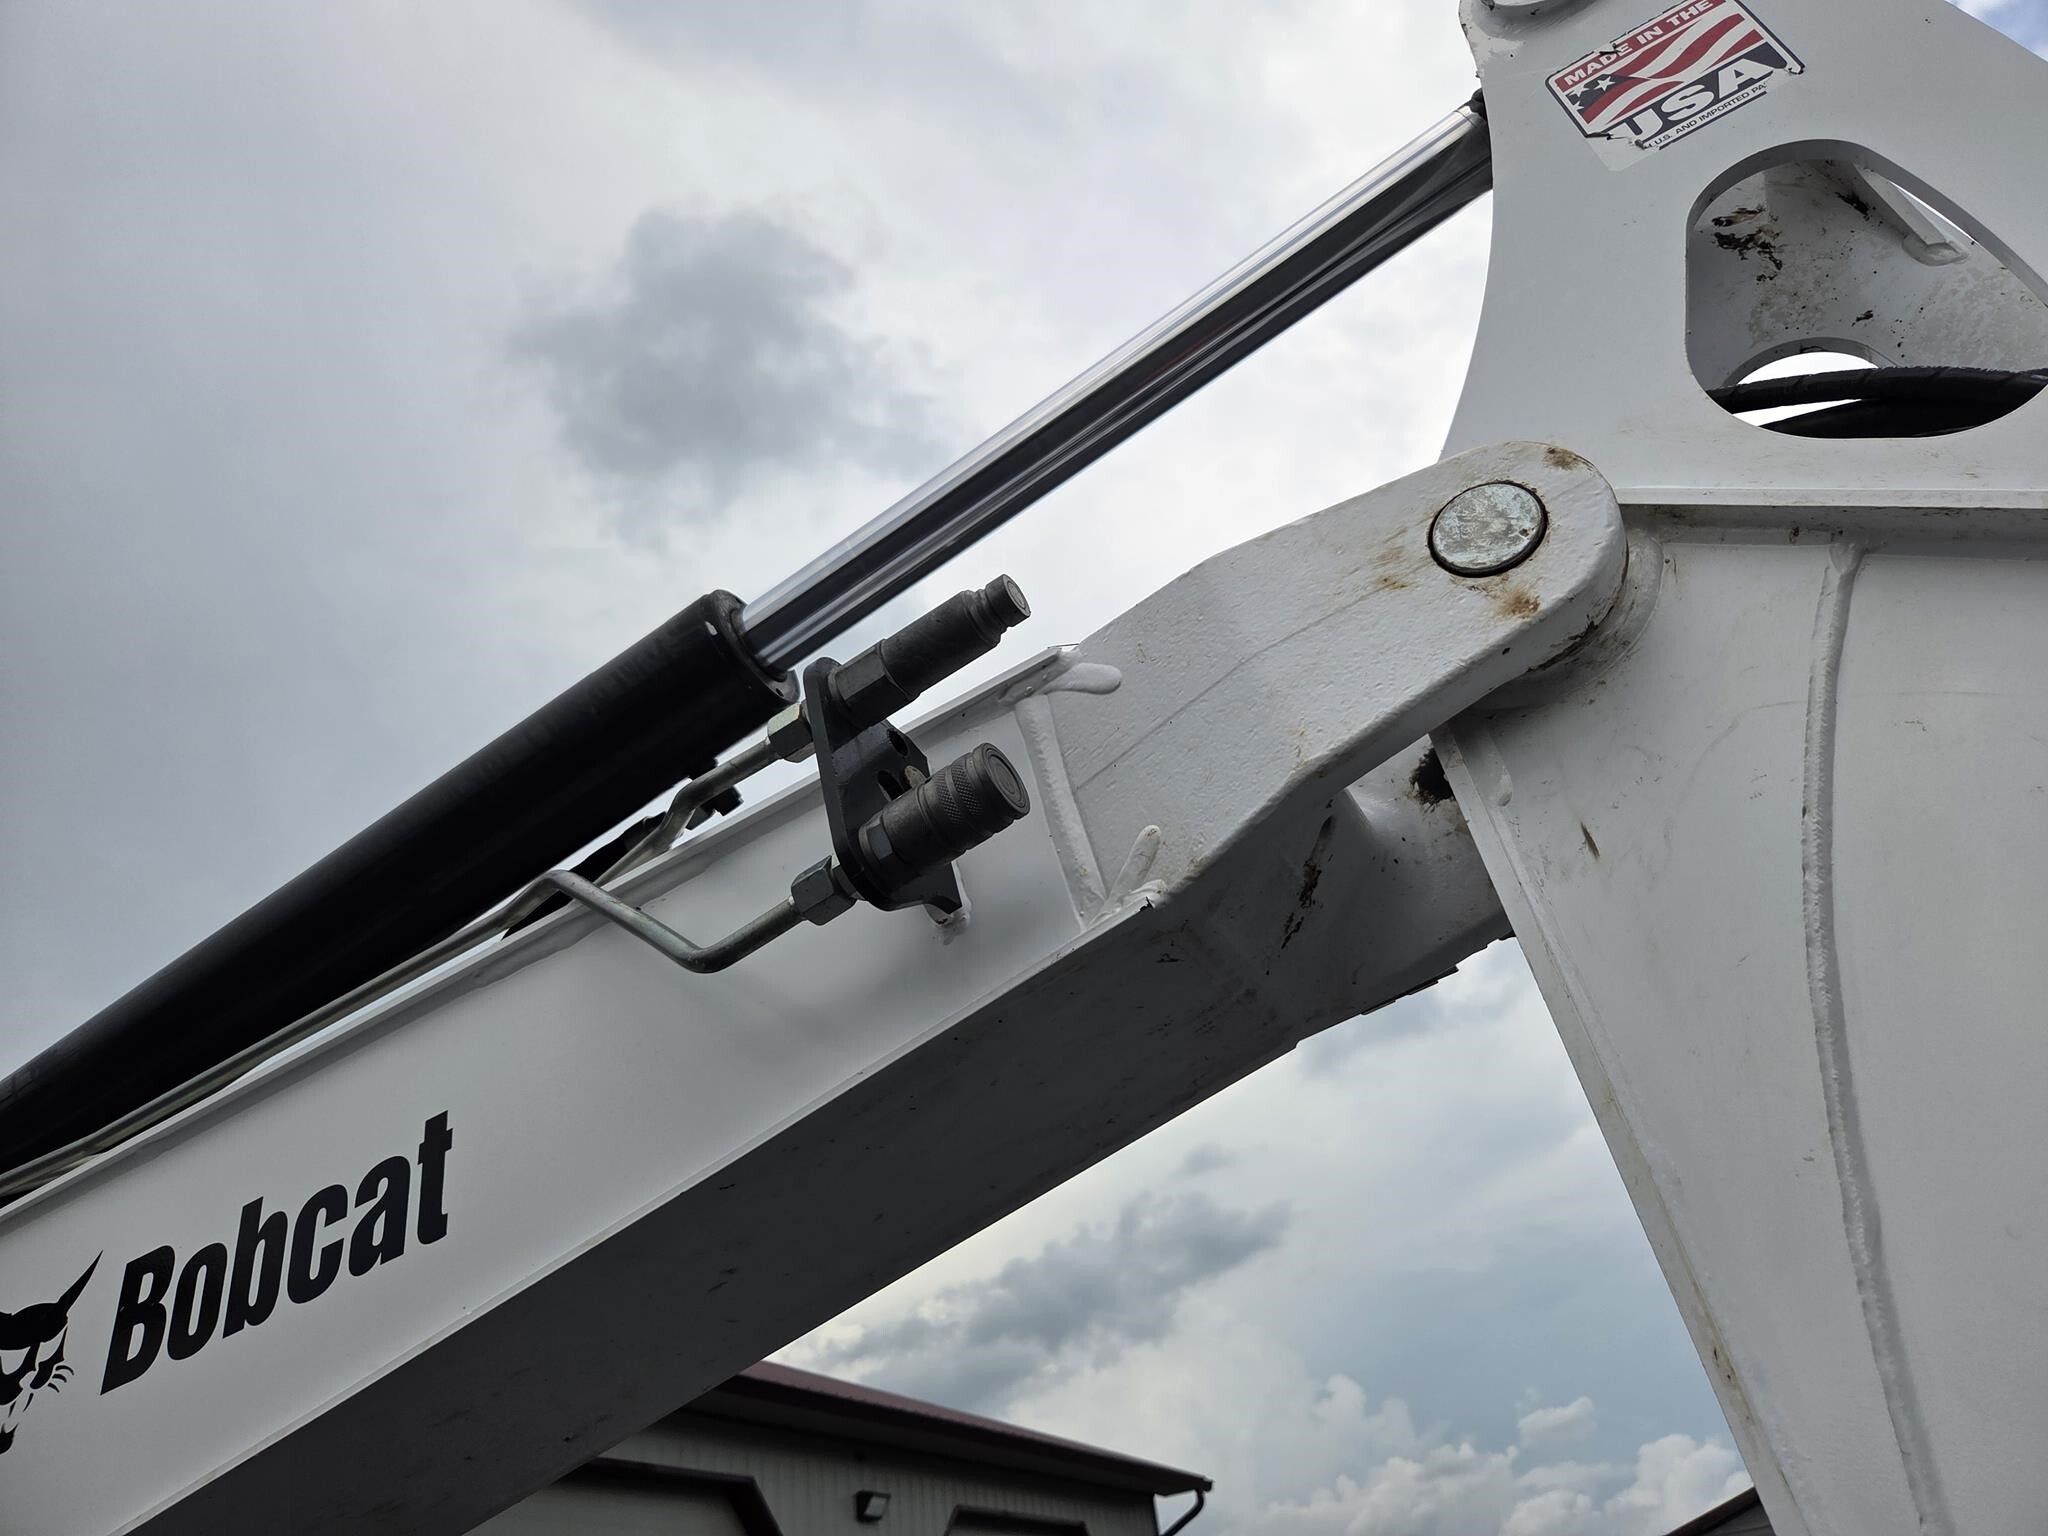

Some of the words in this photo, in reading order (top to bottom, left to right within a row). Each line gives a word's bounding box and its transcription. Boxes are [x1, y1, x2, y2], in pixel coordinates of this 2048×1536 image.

[1564, 43, 1633, 86] MADE
[1636, 26, 1664, 45] IN
[1666, 0, 1714, 26] THE
[1608, 58, 1776, 141] USA
[1654, 134, 1673, 145] U.S.
[1675, 120, 1698, 135] AND
[1698, 92, 1750, 122] IMPORTED
[1752, 82, 1768, 94] PA
[100, 1110, 453, 1396] Bobcat
